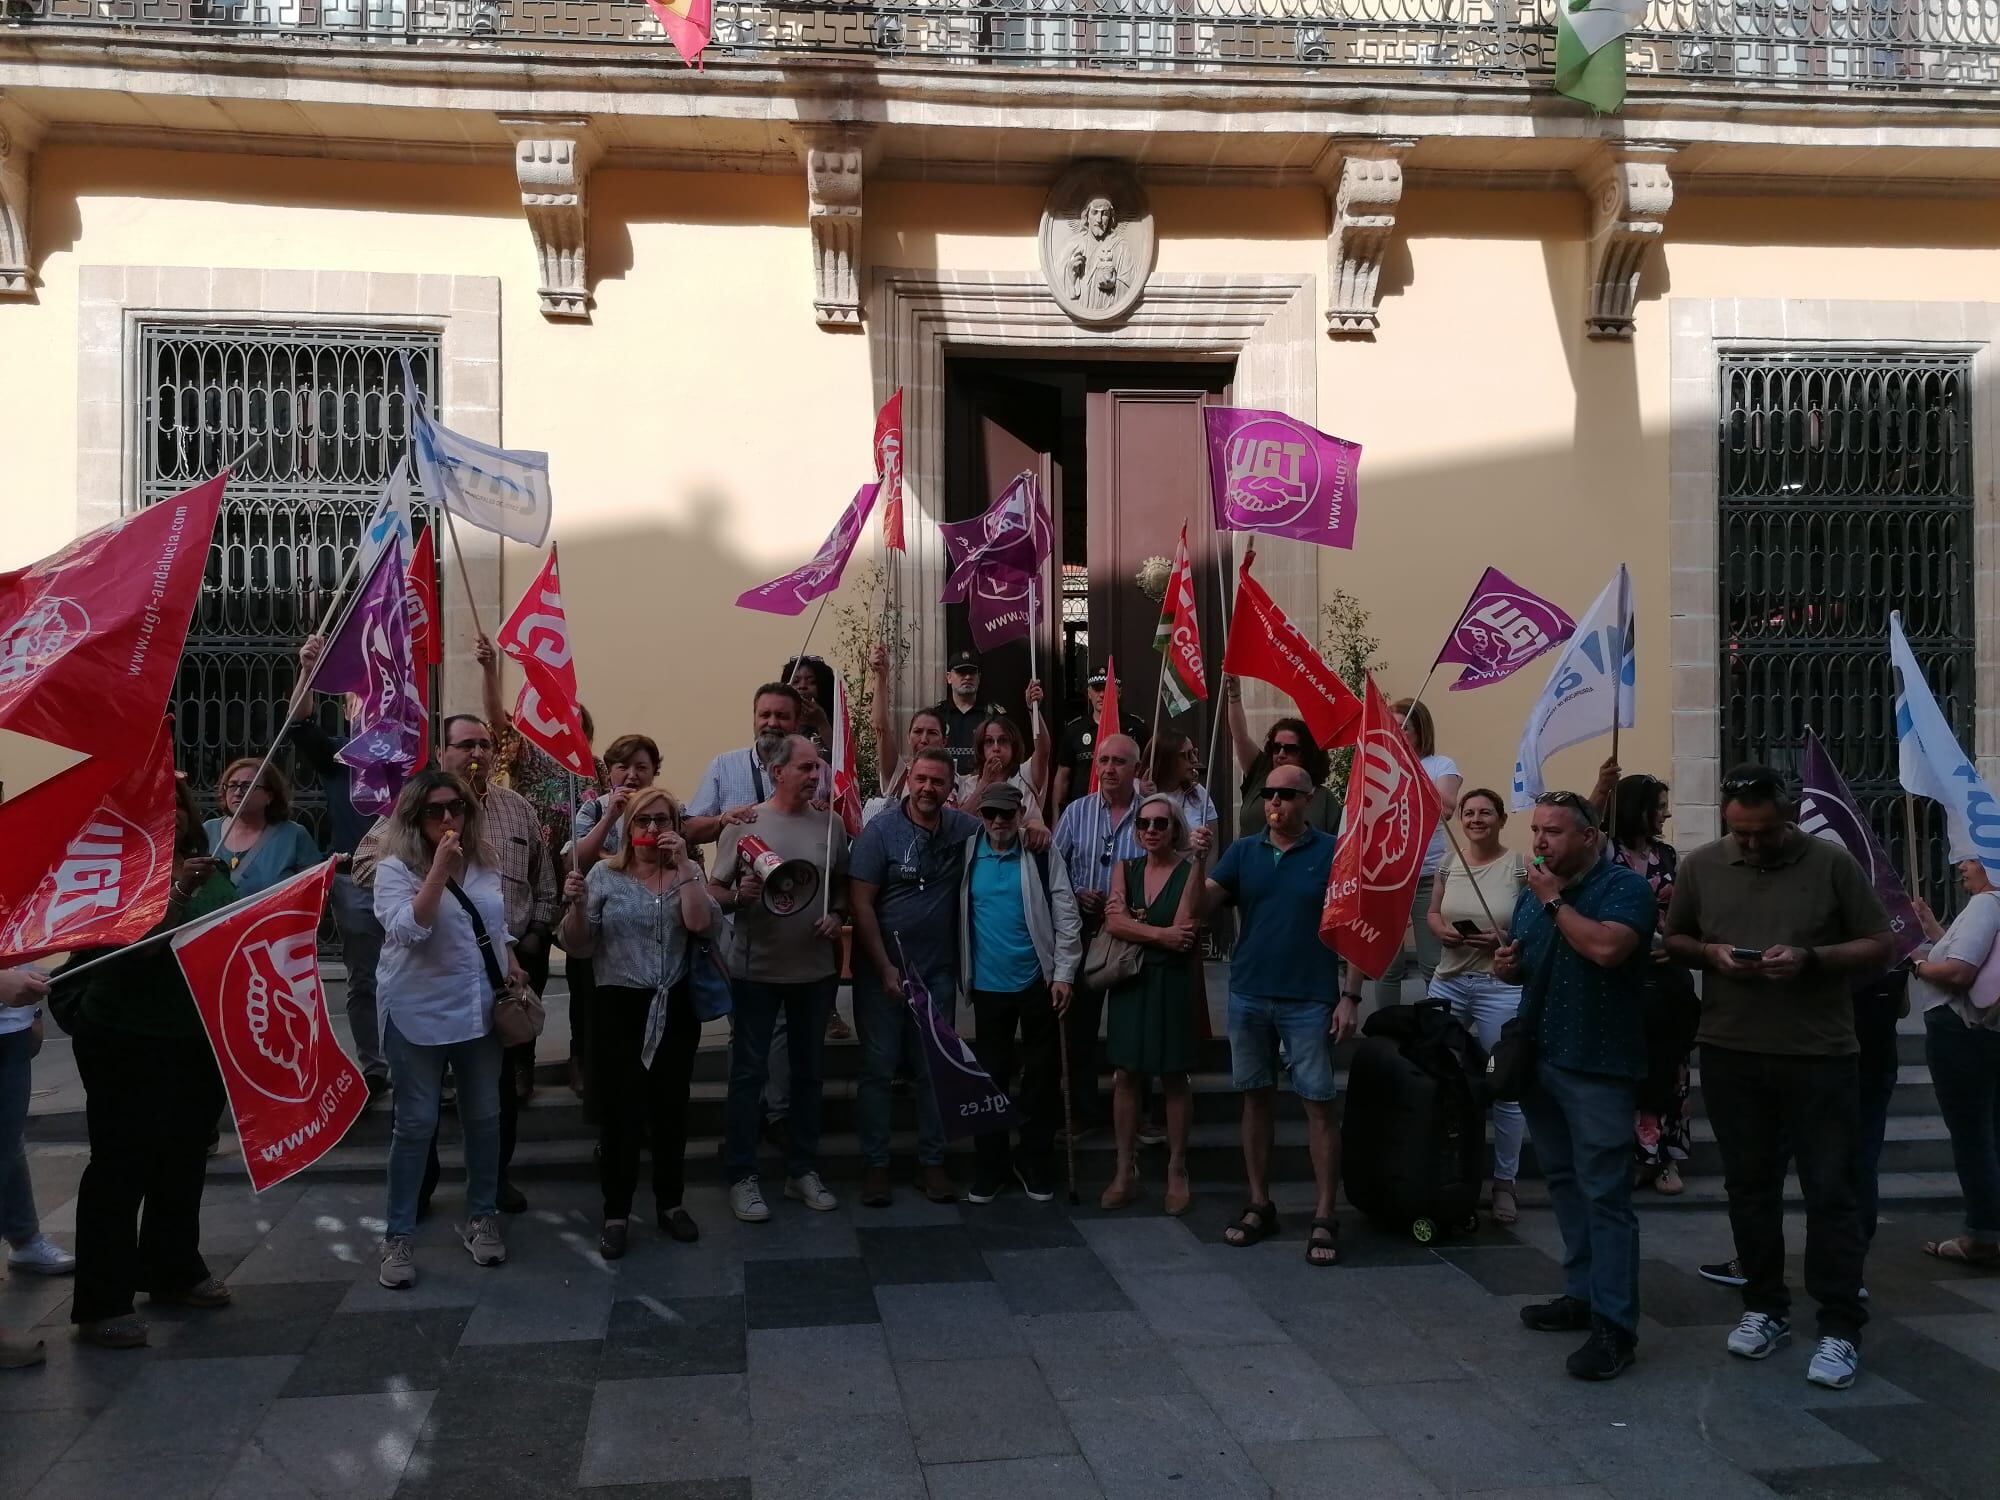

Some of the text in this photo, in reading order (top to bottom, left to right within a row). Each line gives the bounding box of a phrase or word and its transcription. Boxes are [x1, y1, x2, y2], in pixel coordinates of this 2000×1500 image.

[1231, 437, 1306, 485] UGT
[128, 505, 189, 678] www.ugt-andalucia.com
[1475, 599, 1550, 661] UGT
